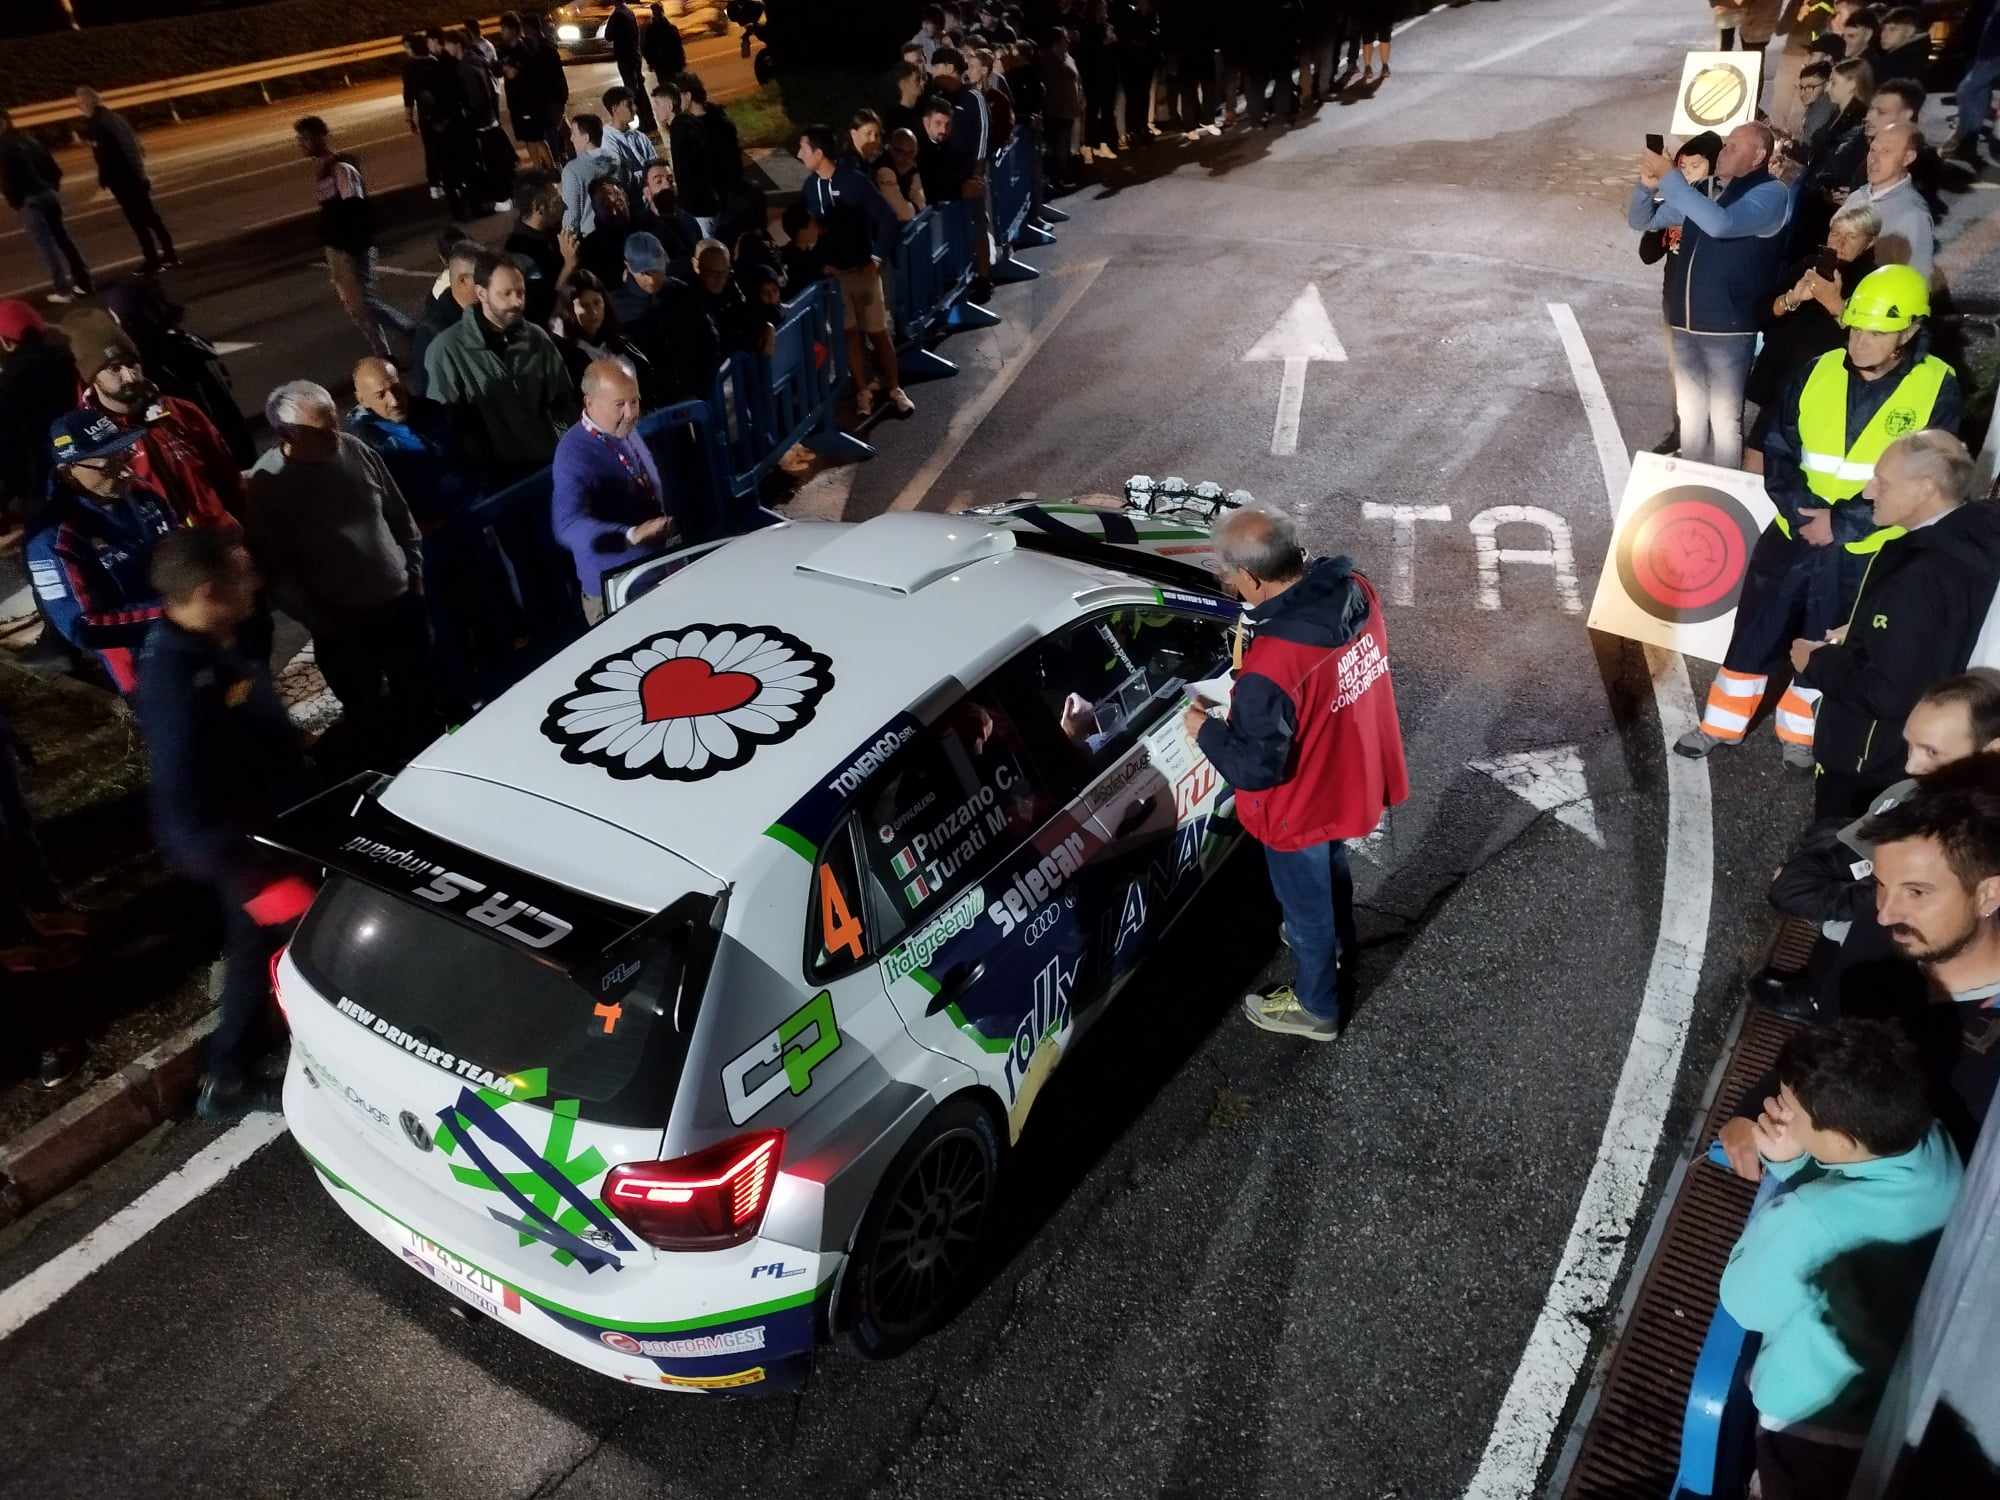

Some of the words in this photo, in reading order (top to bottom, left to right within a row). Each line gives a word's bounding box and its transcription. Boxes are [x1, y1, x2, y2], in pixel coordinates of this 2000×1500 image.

[1337, 633, 1374, 676] ADDETTO
[1338, 645, 1380, 693] RELAZIONI
[829, 731, 902, 798] TONENGO
[897, 727, 917, 743] SRL
[912, 785, 994, 863] Pinzano
[994, 764, 1019, 794] C.
[929, 826, 987, 893] Jurati
[988, 808, 1013, 839] M.
[819, 863, 864, 960] 4
[988, 832, 1085, 938] selecar
[337, 996, 375, 1027] NEW
[455, 1061, 516, 1096] TEAM
[641, 1328, 765, 1355] CONFORMGEST
